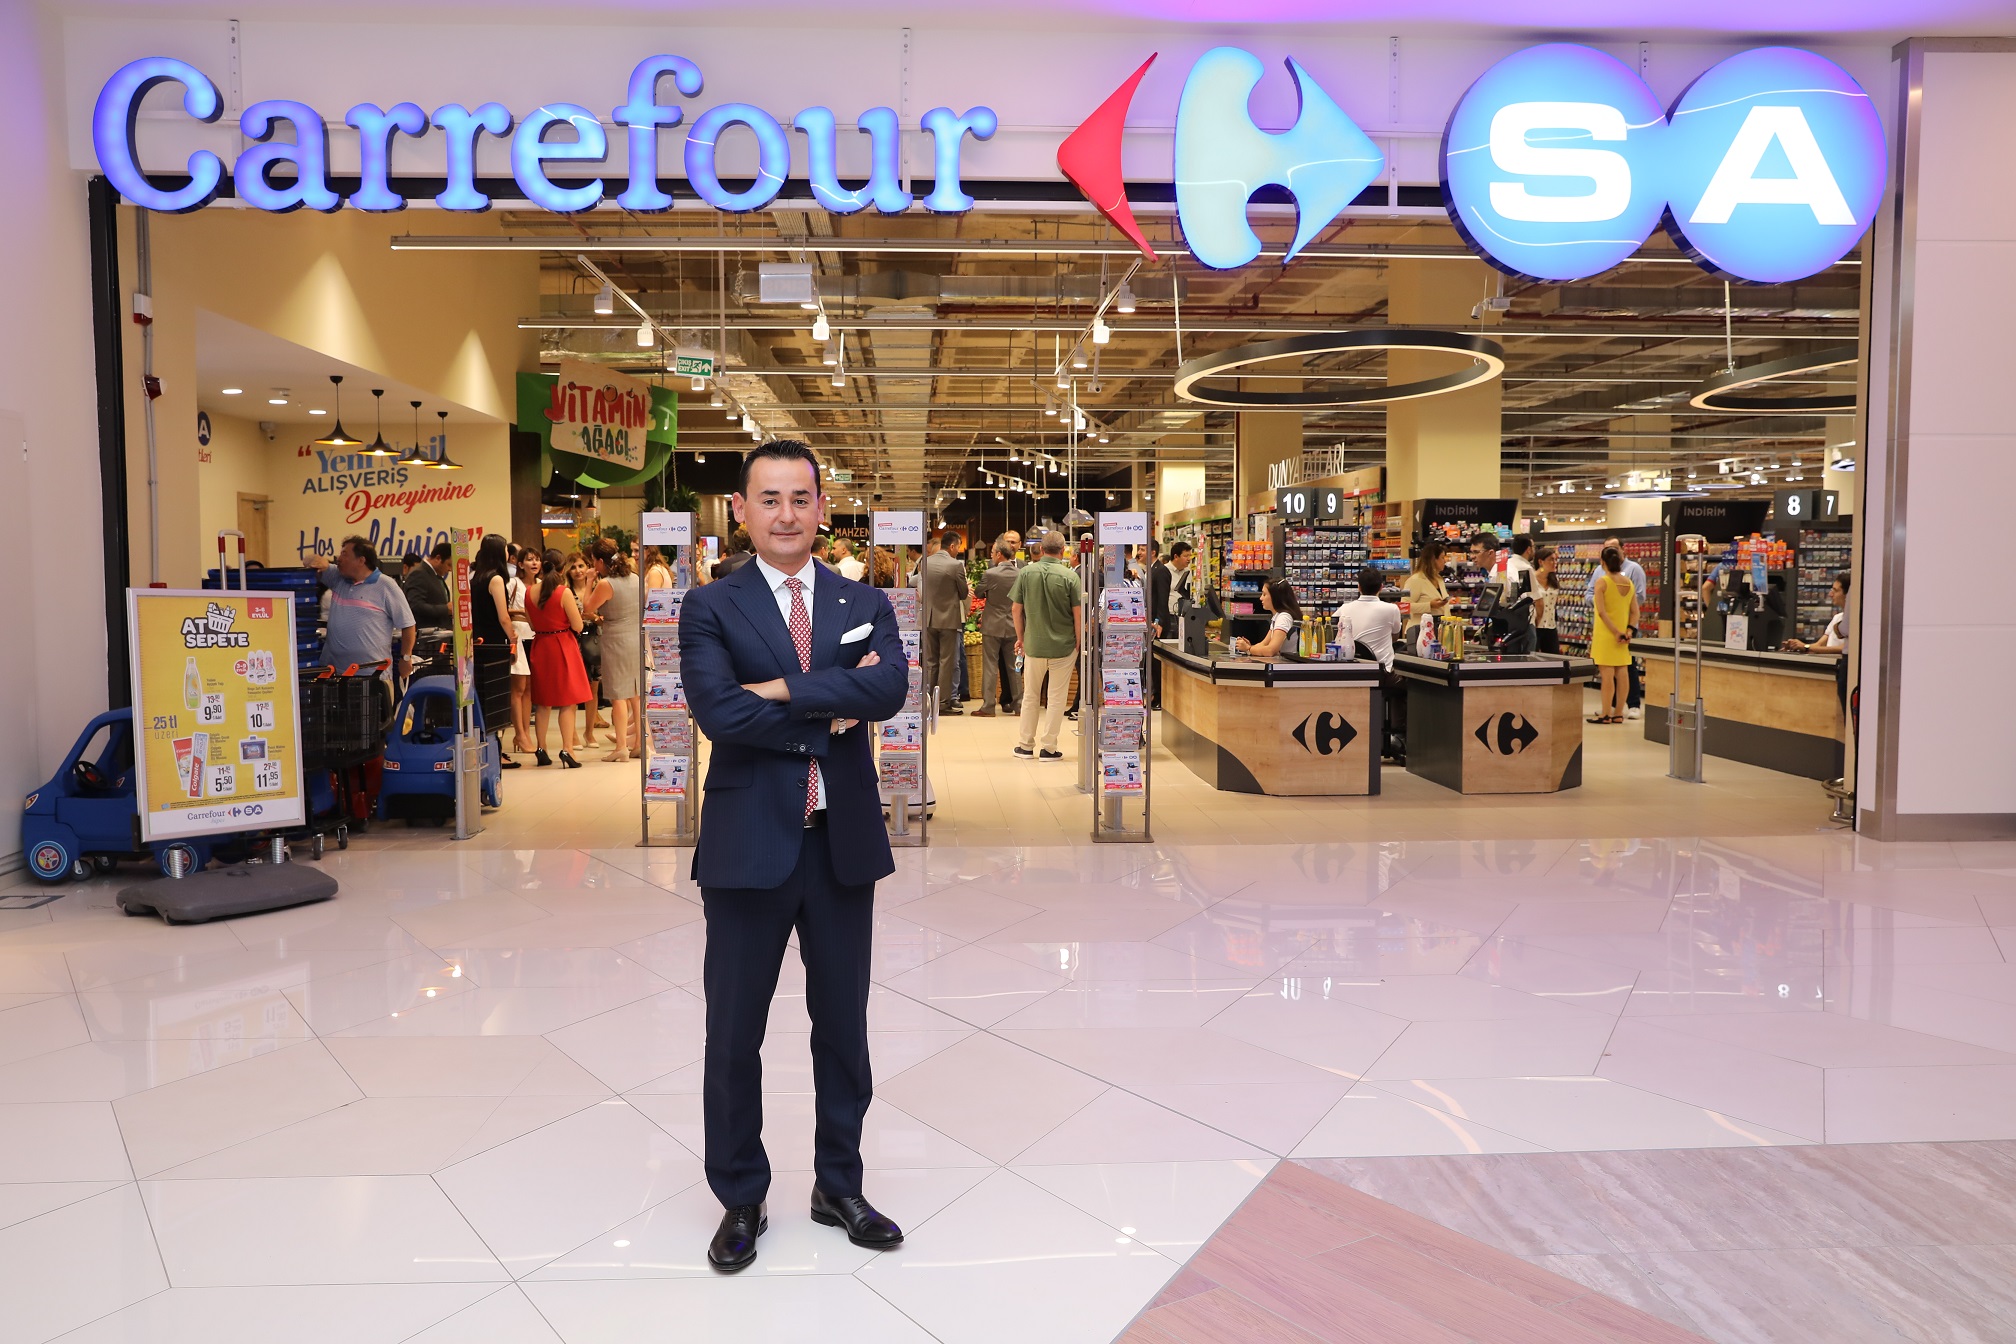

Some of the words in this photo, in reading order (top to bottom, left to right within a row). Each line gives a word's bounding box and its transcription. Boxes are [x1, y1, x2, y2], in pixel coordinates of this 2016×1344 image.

[93, 54, 998, 215] Carrefour
[344, 481, 477, 525] Deneyimine
[1282, 492, 1305, 514] 10
[1326, 492, 1337, 514] 9
[1786, 495, 1801, 516] 8
[1826, 495, 1835, 516] 7
[182, 618, 208, 634] AT
[185, 633, 249, 648] SEPETE
[204, 704, 222, 720] 9,90
[250, 713, 263, 728] 10
[153, 716, 167, 730] 25
[169, 715, 178, 729] tl
[191, 762, 200, 791] Colgate
[215, 775, 233, 792] 5,50
[256, 771, 279, 788] 11,95
[187, 809, 225, 821] Carrefour
